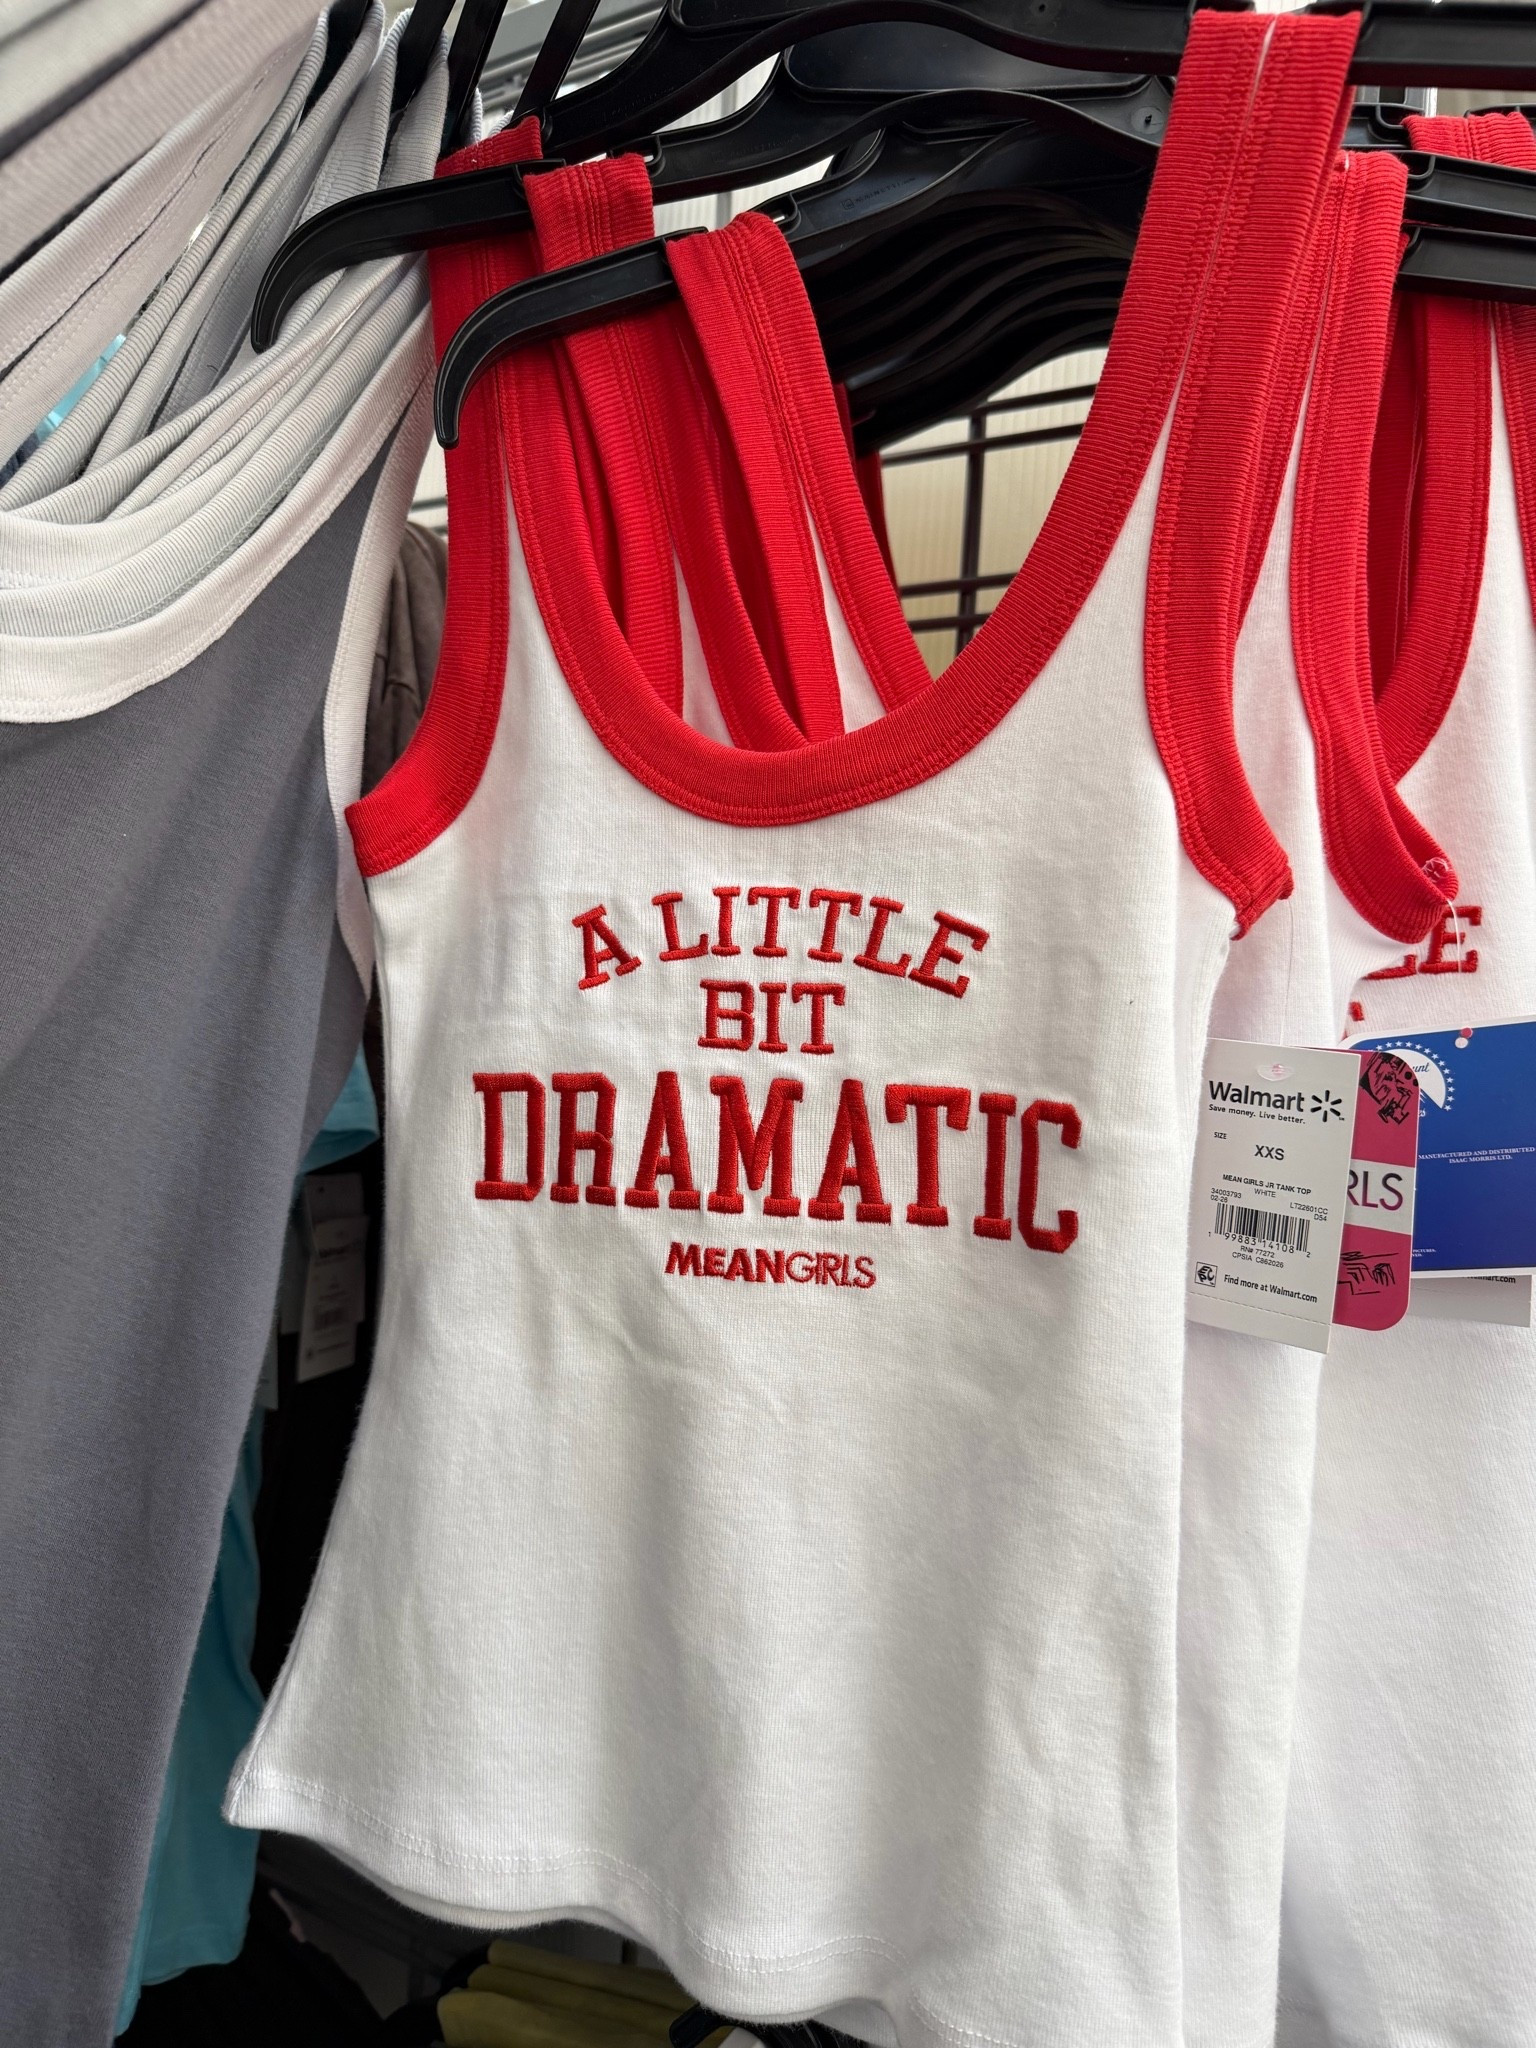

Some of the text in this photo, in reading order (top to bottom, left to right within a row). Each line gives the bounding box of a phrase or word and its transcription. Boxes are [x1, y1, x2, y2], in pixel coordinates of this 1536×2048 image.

[572, 886, 990, 998] A LITTLE
[697, 979, 846, 1055] BIT
[1208, 1080, 1304, 1112] Walmart
[1209, 1104, 1306, 1124] Save money. Live better.
[472, 1071, 1082, 1254] DRAMATIC
[1254, 1145, 1285, 1160] XXS
[1418, 1151, 1472, 1160] MANUFACTURED
[1488, 1146, 1535, 1155] DISTRIBUTED
[1222, 1174, 1312, 1196] MEAN GIRLS JR TANK TOP
[1254, 1188, 1276, 1198] WHITE
[1224, 1232, 1257, 1246] 99883
[1262, 1240, 1295, 1254] 14108
[1255, 1248, 1275, 1258] 77272
[1232, 1252, 1253, 1262] CPSIA
[1224, 1274, 1318, 1303] Find more at Walmart.com
